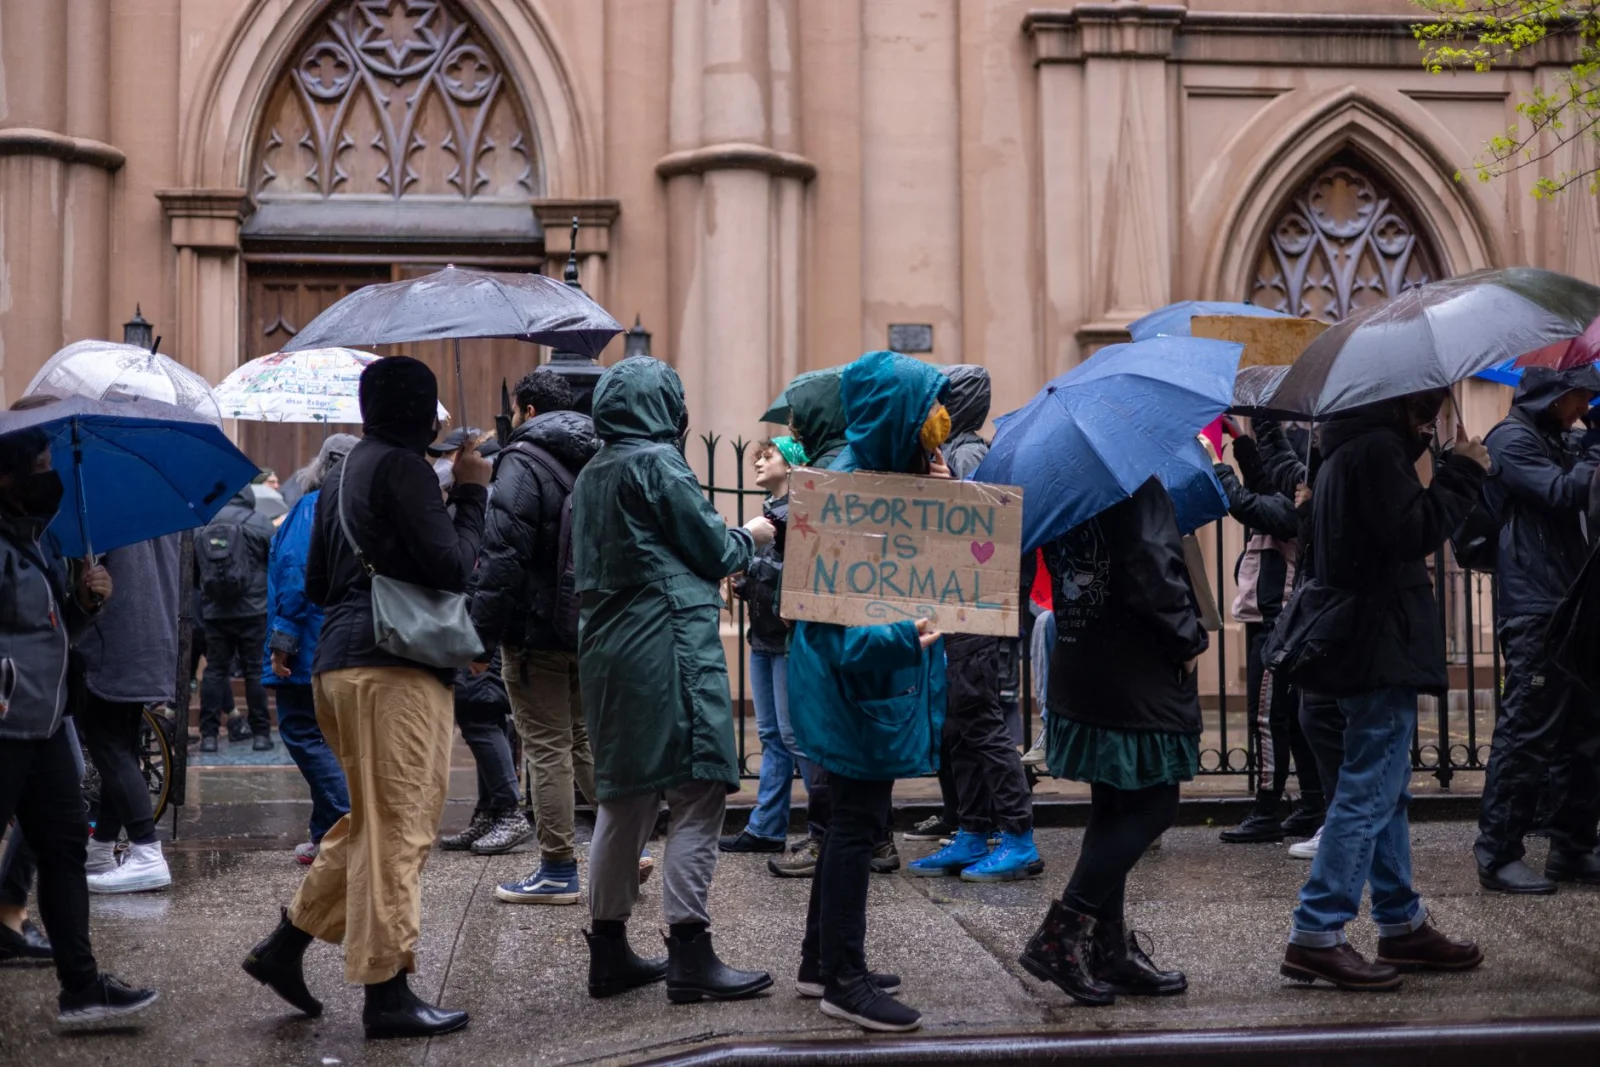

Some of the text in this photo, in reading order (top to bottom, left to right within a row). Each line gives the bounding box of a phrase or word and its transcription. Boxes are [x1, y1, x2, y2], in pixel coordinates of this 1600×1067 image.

[820, 493, 996, 537] ABORTION
[881, 532, 918, 559] IS
[813, 554, 1002, 609] NORMAL
